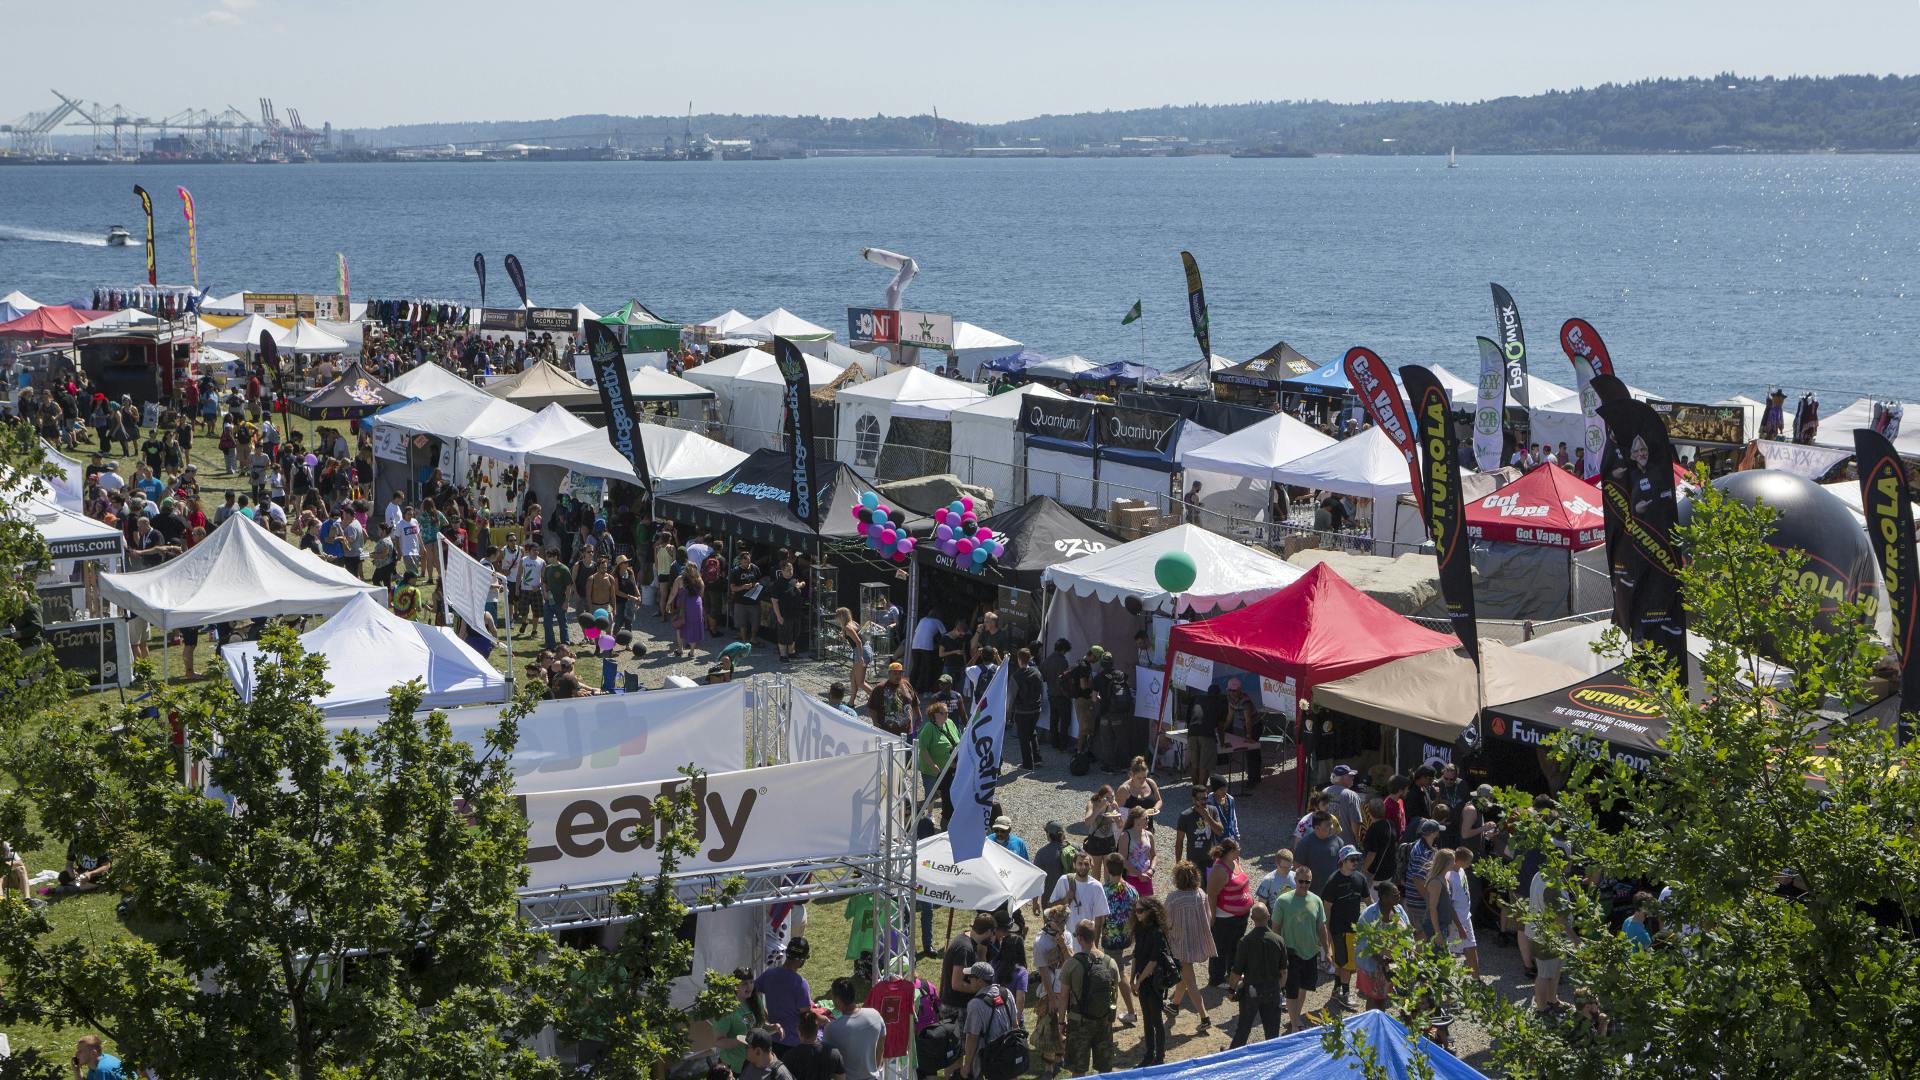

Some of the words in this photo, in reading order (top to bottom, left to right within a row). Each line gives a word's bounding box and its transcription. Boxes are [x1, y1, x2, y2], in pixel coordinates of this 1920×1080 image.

[602, 361, 641, 478] oticgenetix
[1030, 406, 1076, 431] Quantum
[1374, 390, 1407, 441] Vape
[1110, 416, 1163, 441] Quantum
[732, 483, 791, 503] exoticgene
[1482, 493, 1520, 508] Got
[1501, 505, 1550, 517] Vape
[1467, 526, 1483, 537] ape
[1516, 528, 1533, 540] Got
[1536, 529, 1562, 544] Vape
[1580, 530, 1591, 541] Got
[1593, 529, 1606, 542] Vap
[50, 539, 117, 555] arms.com
[1054, 538, 1107, 558] eZip
[935, 554, 955, 567] ONLY
[53, 629, 114, 648] Farms
[1552, 706, 1565, 715] THE
[1564, 708, 1588, 719] DUTCH
[1586, 711, 1615, 725] ROLLING
[1615, 719, 1649, 734] COMPANY
[1571, 719, 1593, 730] SINCE
[1593, 724, 1610, 733] 1996
[971, 715, 1001, 831] Leafly.co
[522, 774, 758, 862] Leafly
